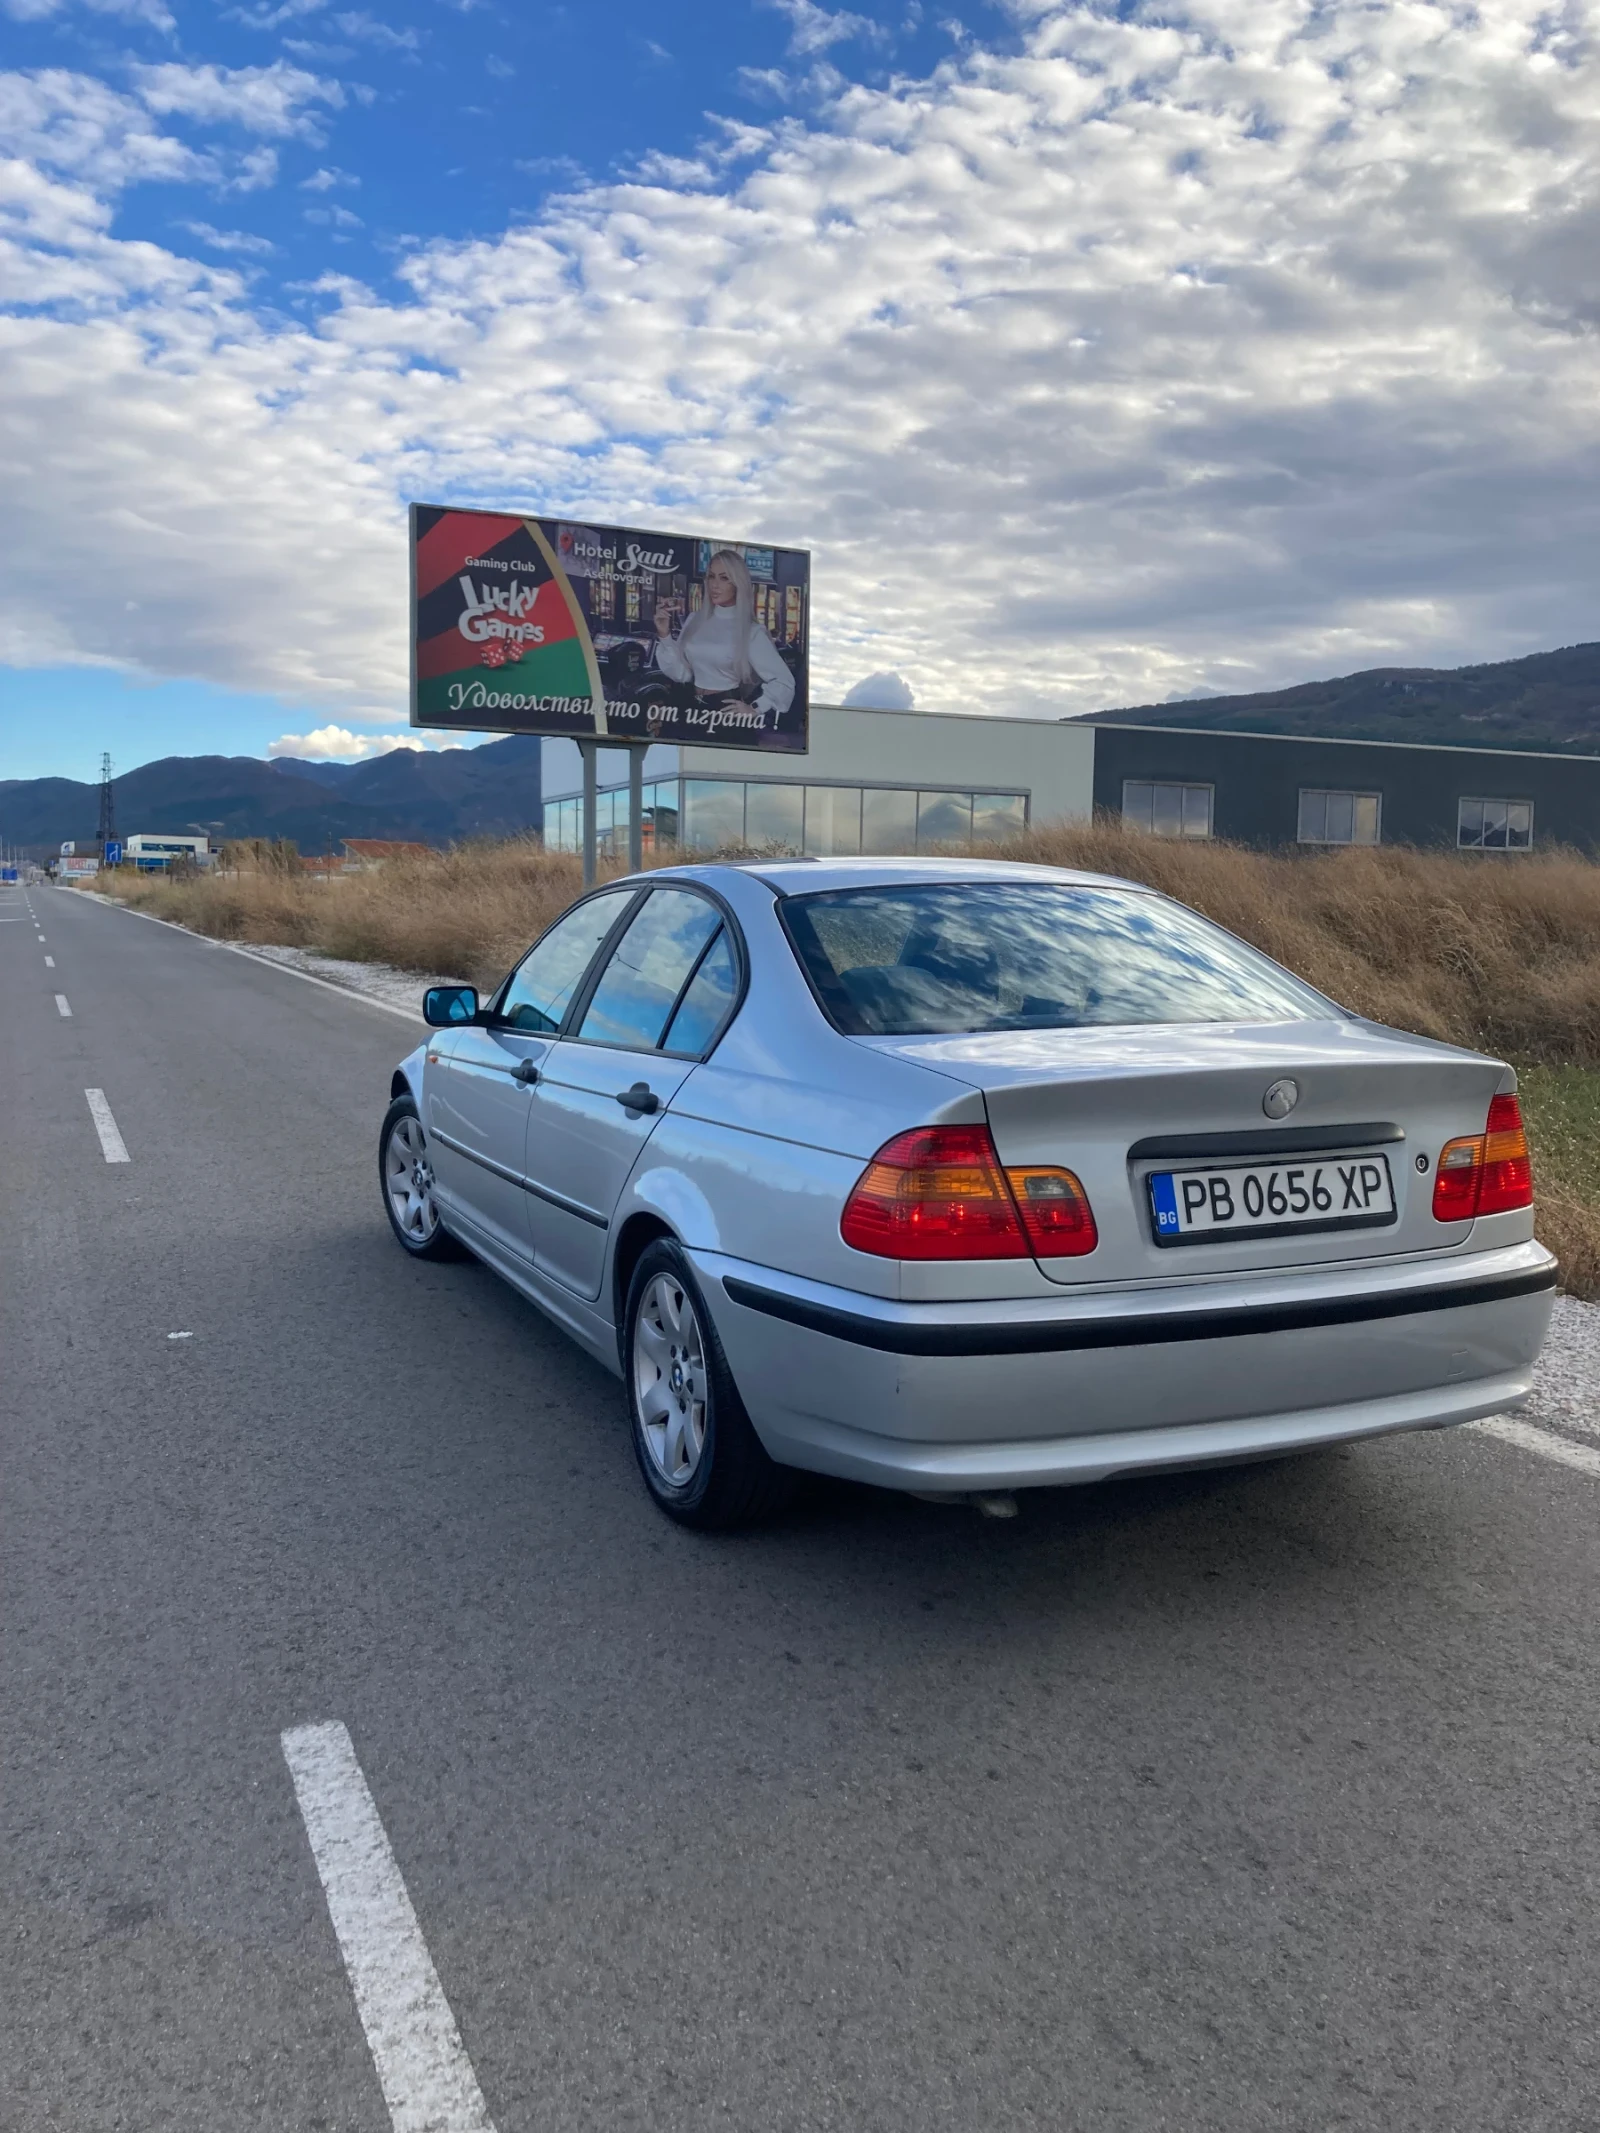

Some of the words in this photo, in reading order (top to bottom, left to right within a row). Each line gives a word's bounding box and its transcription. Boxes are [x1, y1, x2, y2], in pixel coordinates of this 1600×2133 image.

[464, 556, 508, 572] Gaming
[510, 560, 536, 572] Club
[573, 542, 617, 560] Hotel
[617, 543, 680, 574] Sani
[583, 568, 653, 585] Asenovgrad
[459, 575, 539, 618] Lucky
[458, 607, 545, 642] Games
[647, 705, 679, 722] от
[1181, 1177, 1236, 1225] PB
[1243, 1168, 1333, 1218] 0656
[1337, 1164, 1382, 1210] XP
[1159, 1211, 1177, 1225] BG
